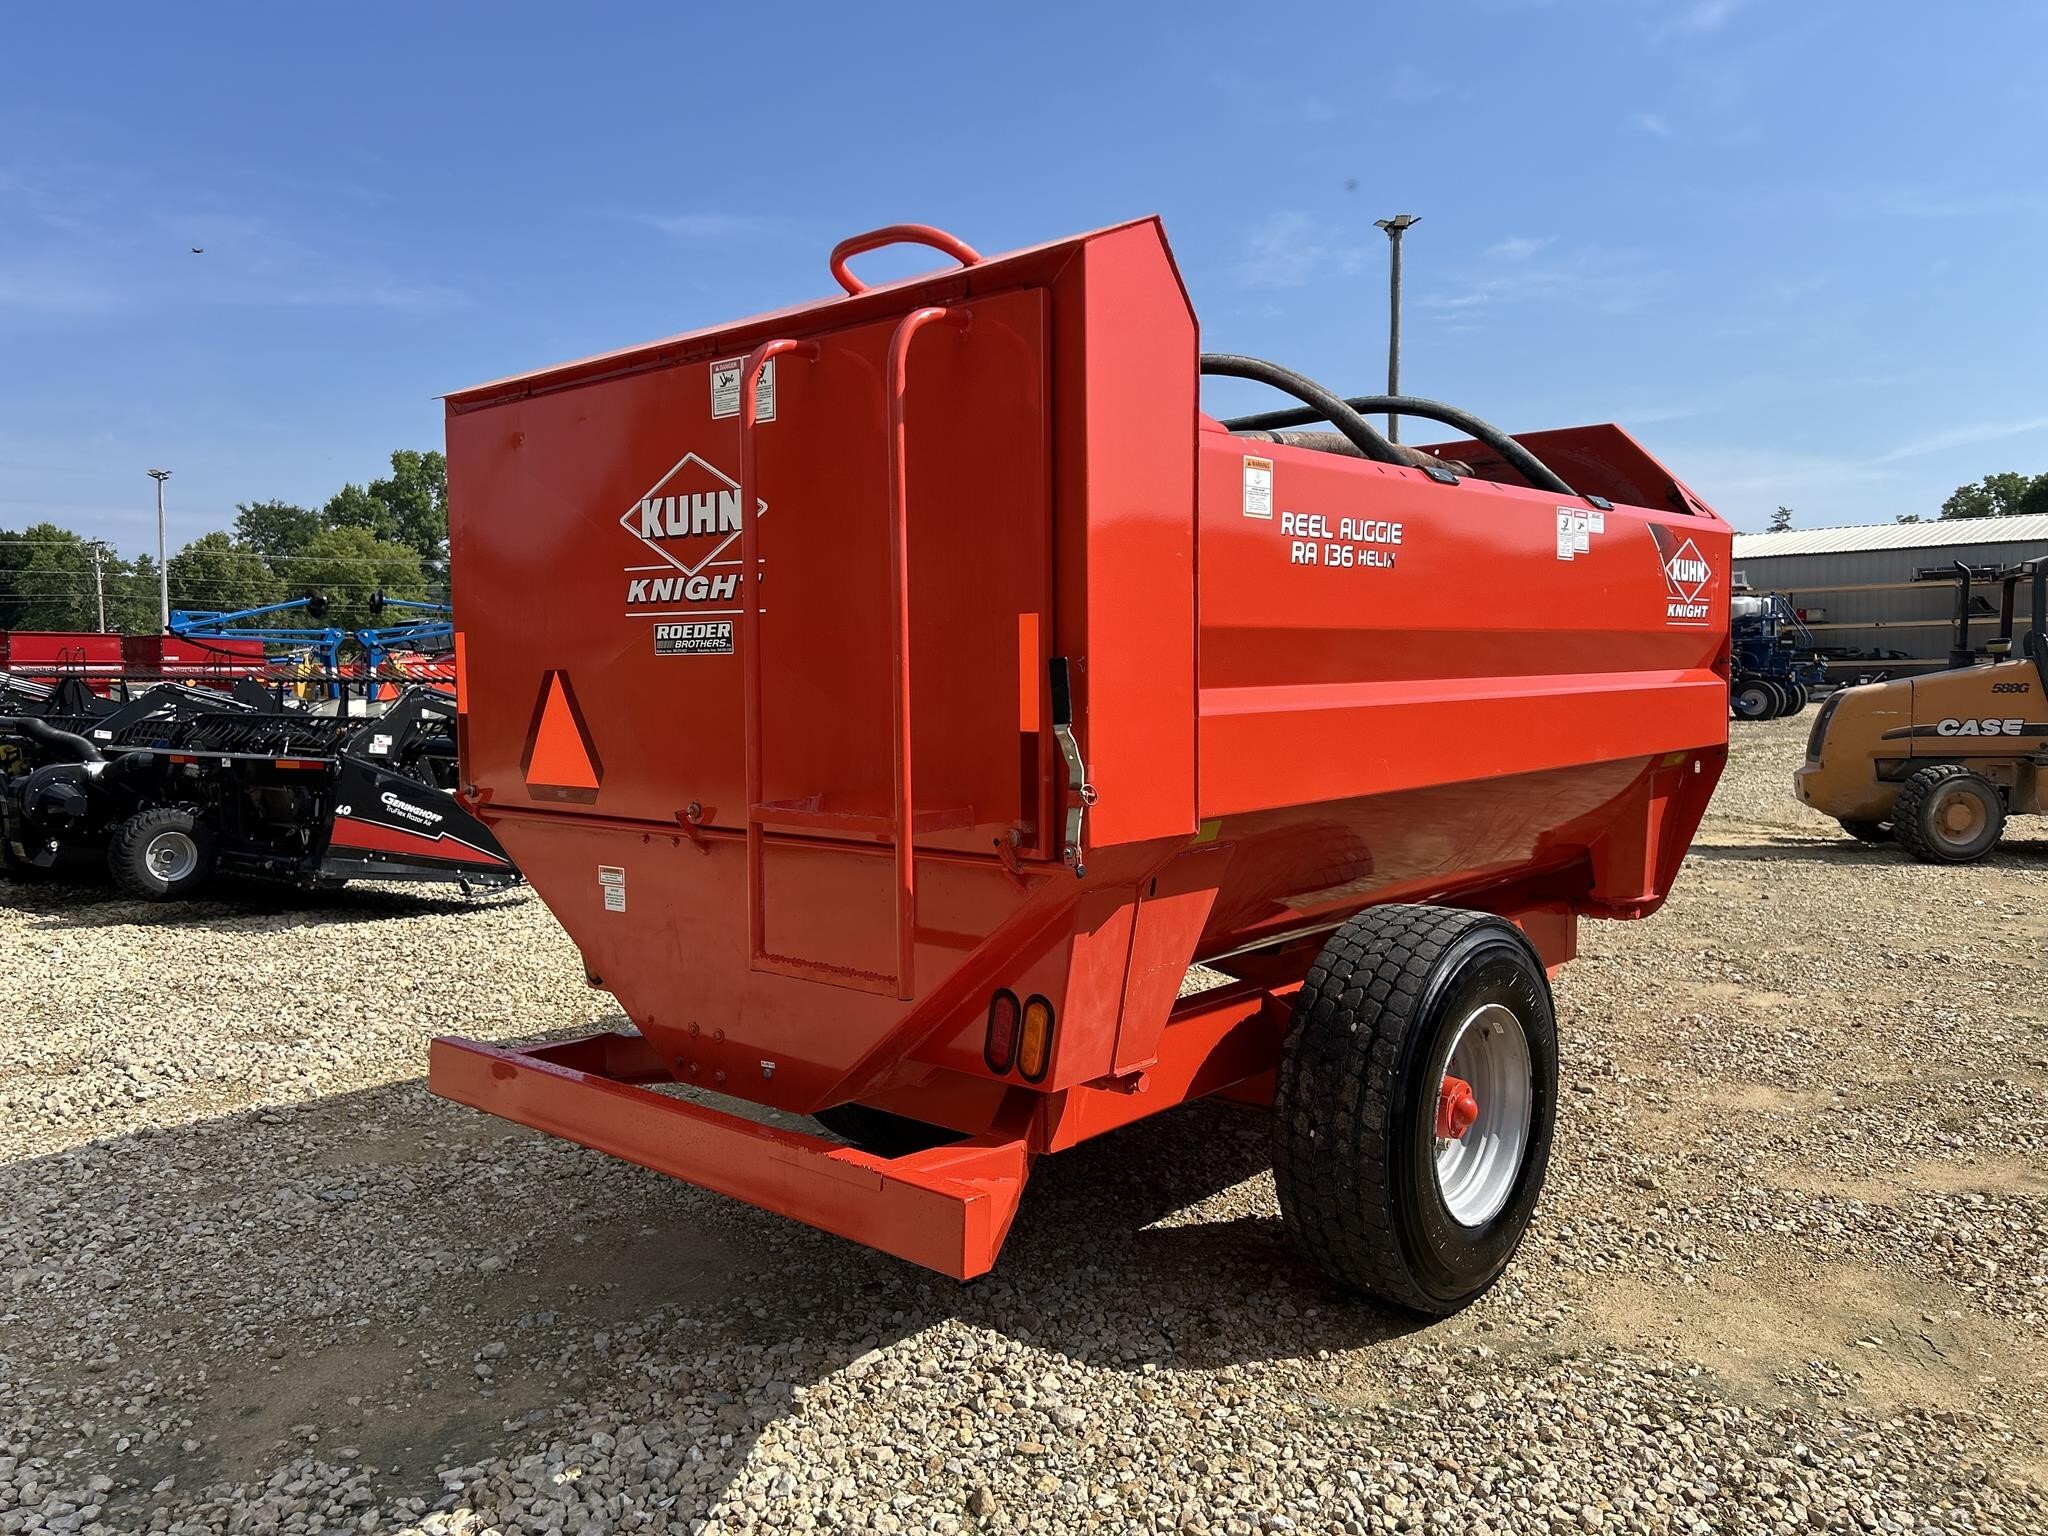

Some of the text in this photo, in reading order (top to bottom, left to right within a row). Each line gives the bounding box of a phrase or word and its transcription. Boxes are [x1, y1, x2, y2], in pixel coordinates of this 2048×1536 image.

[641, 489, 742, 538] KUHN
[1281, 511, 1402, 544] REEL AUGGIE
[1291, 541, 1396, 568] RA 136 HELIX
[1672, 558, 1705, 582] KUHN
[1667, 604, 1709, 618] KNIGHT
[656, 623, 731, 640] ROEDER
[674, 639, 727, 649] BROTHERS
[1992, 682, 2030, 694] 588G
[1936, 718, 2025, 736] CASE
[335, 804, 352, 816] 40
[386, 805, 432, 827] TruFlex Razor Air
